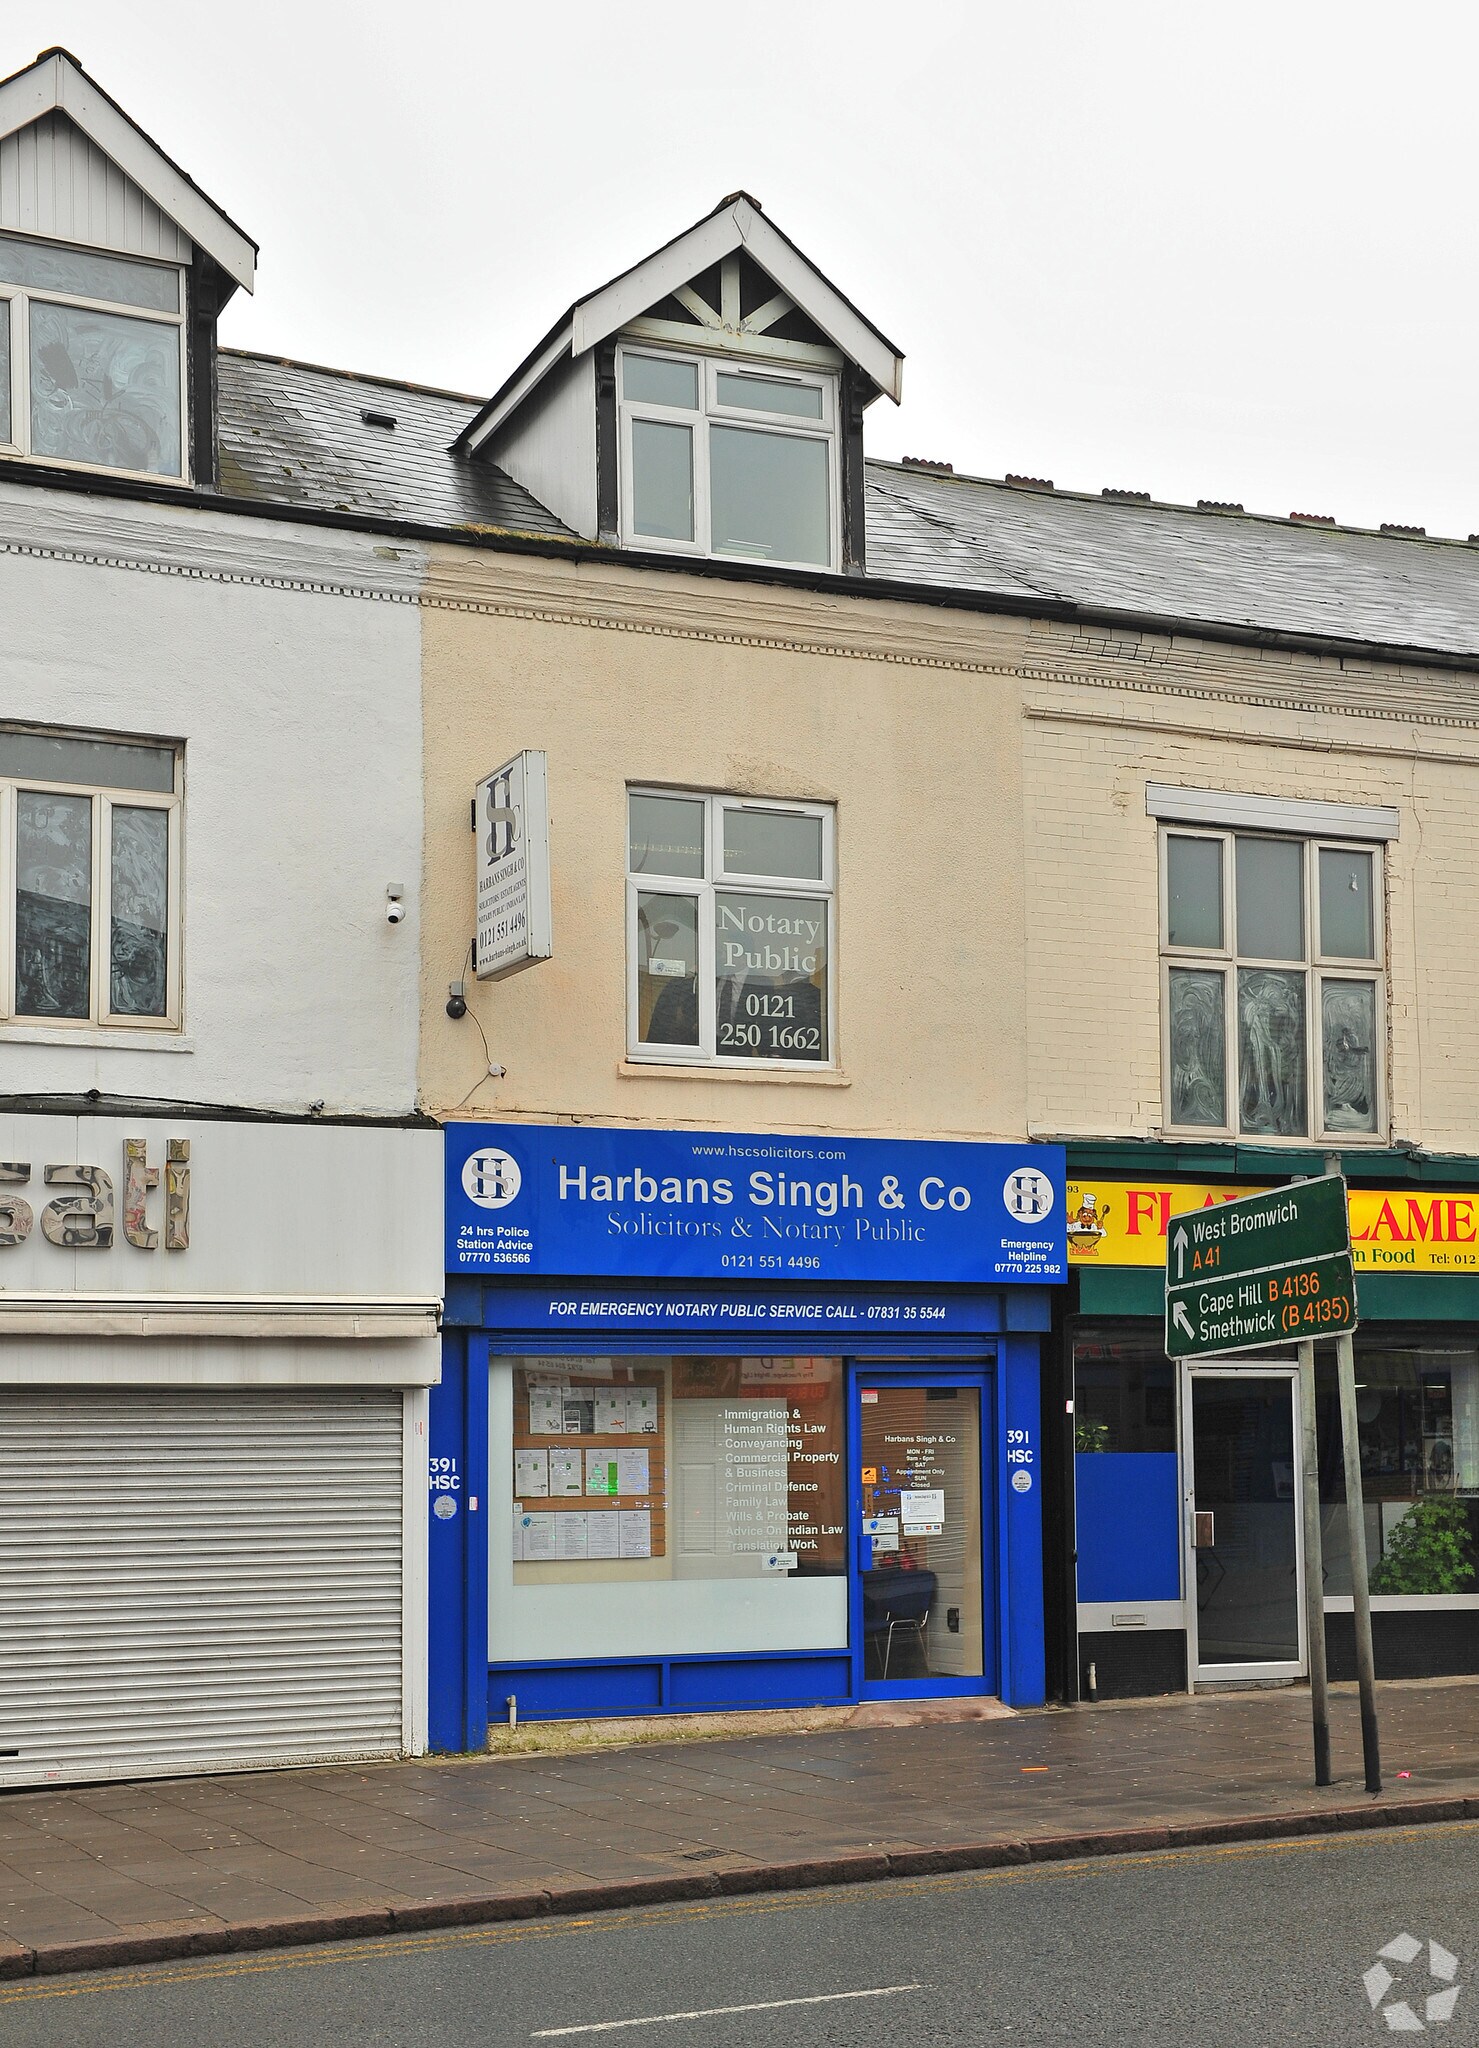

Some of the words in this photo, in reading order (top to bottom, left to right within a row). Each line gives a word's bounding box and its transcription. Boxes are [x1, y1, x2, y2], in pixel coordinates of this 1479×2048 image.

[479, 871, 500, 893] HARBANS
[500, 864, 514, 882] SINGH
[517, 856, 525, 872] CO
[479, 926, 495, 949] 0121
[497, 919, 508, 941] 551
[510, 910, 526, 933] 4496
[717, 905, 821, 944] Notary
[722, 941, 816, 974] Public
[745, 994, 796, 1018] 0121
[719, 1022, 761, 1048] 250
[769, 1024, 820, 1050] 1662
[692, 1145, 846, 1160] www.hscsolicitors.com
[558, 1165, 734, 1206] Harbans
[749, 1170, 863, 1217] Singh
[878, 1175, 906, 1210] &
[919, 1176, 971, 1212] Co
[607, 1210, 722, 1238] Solicitors
[731, 1215, 752, 1239] &
[763, 1215, 846, 1247] Notary
[856, 1217, 926, 1243] Public
[1193, 1217, 1226, 1244] West
[1230, 1200, 1298, 1235] Bromwich
[460, 1225, 473, 1236] 24
[476, 1225, 494, 1236] hrs
[497, 1226, 529, 1237] Police
[456, 1238, 495, 1250] Station
[497, 1239, 533, 1251] Advice
[1000, 1239, 1054, 1252] Emergency
[459, 1252, 491, 1263] 07770
[493, 1252, 530, 1264] 536566
[721, 1254, 753, 1268] 0121
[759, 1255, 782, 1268] 551
[788, 1256, 820, 1269] 4496
[1008, 1251, 1047, 1263] Helpline
[1192, 1249, 1203, 1271] A
[1204, 1246, 1221, 1268] 41
[1372, 1248, 1415, 1263] Food
[1429, 1253, 1450, 1264] Tel:
[1454, 1255, 1479, 1264] 012
[994, 1263, 1023, 1274] 07770
[1024, 1264, 1042, 1274] 225
[1043, 1264, 1061, 1274] 982
[1200, 1292, 1234, 1316] Cape
[1238, 1283, 1263, 1307] Hill
[1268, 1280, 1279, 1302] B
[1282, 1271, 1320, 1298] 4136
[549, 1302, 577, 1316] FOR
[580, 1302, 663, 1317] EMERGENCY
[665, 1303, 718, 1317] NOTARY
[720, 1304, 767, 1318] PUBLIC
[769, 1305, 822, 1318] SERVICE
[825, 1306, 857, 1318] CALL
[867, 1306, 900, 1319] 07831
[903, 1307, 917, 1319] 35
[919, 1307, 946, 1320] 5544
[1200, 1310, 1276, 1342] Smethwick
[1281, 1305, 1300, 1332] (B
[1303, 1296, 1350, 1323] 4135)
[724, 1409, 789, 1421] Immigration
[793, 1409, 801, 1419] &
[724, 1424, 763, 1434] Human
[766, 1424, 801, 1435] Rights
[804, 1424, 826, 1433] Law
[725, 1438, 803, 1450] Conveyancing
[884, 1435, 914, 1443] Harbans
[916, 1436, 937, 1444] Singh
[938, 1435, 944, 1443] &
[1007, 1430, 1029, 1444] 391
[725, 1452, 790, 1463] Commercial
[793, 1452, 839, 1464] Property
[1007, 1449, 1033, 1463] HSC
[429, 1457, 456, 1472] 391
[725, 1468, 733, 1478] &
[736, 1467, 787, 1478] Business
[429, 1474, 460, 1490] HSC
[725, 1482, 771, 1492] Criminal
[774, 1481, 818, 1492] Defence
[726, 1496, 761, 1509] Family
[765, 1496, 787, 1507] Law
[726, 1511, 752, 1521] Wills
[755, 1511, 763, 1521] &
[767, 1511, 809, 1521] Probate
[726, 1525, 763, 1536] Advice
[767, 1525, 782, 1536] On
[786, 1525, 818, 1535] Indian
[821, 1525, 843, 1534] Law
[727, 1540, 787, 1551] Translation
[789, 1539, 818, 1549] Work
